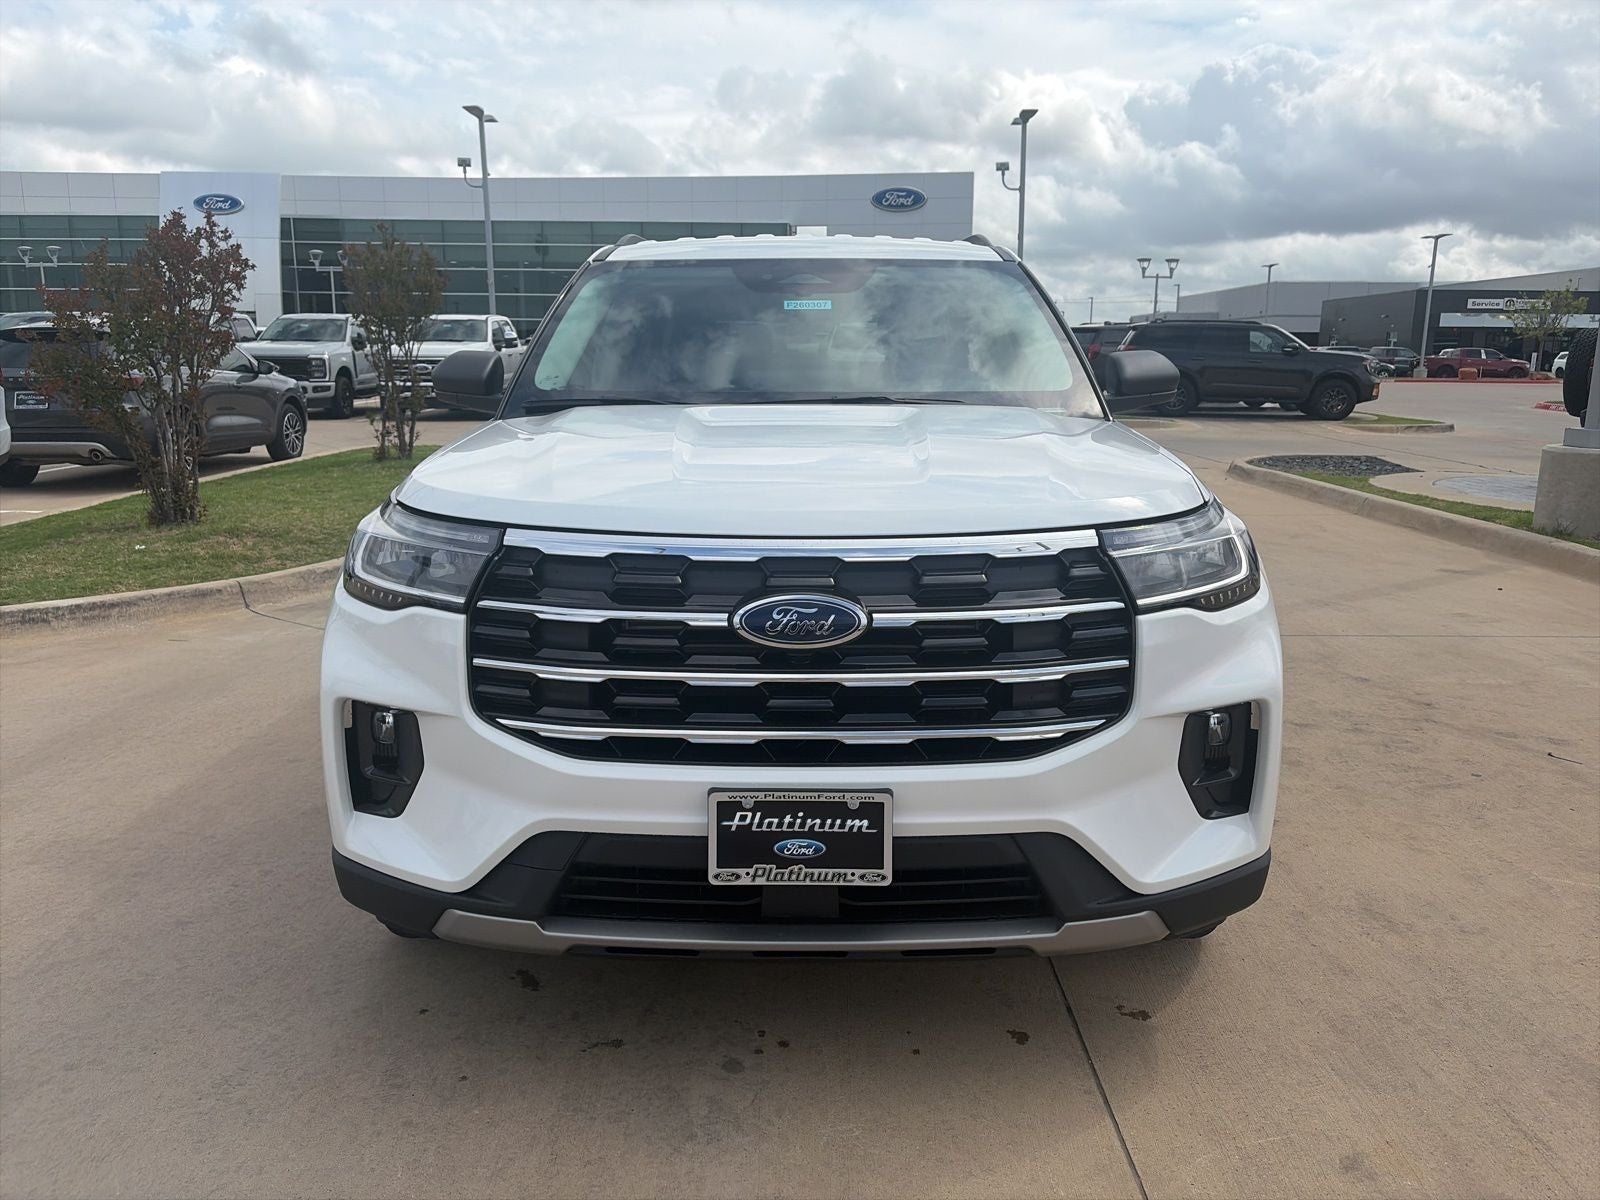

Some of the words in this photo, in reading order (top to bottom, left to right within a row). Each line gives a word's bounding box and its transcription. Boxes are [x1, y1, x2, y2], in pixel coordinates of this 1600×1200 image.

[202, 196, 231, 209] Ford
[882, 191, 914, 206] Ford
[786, 301, 828, 309] F260307
[765, 606, 836, 635] Ford
[727, 793, 875, 801] www.PlatinumFord.com
[720, 811, 878, 833] Platinum
[783, 841, 815, 856] Ford
[751, 865, 856, 883] Platinum
